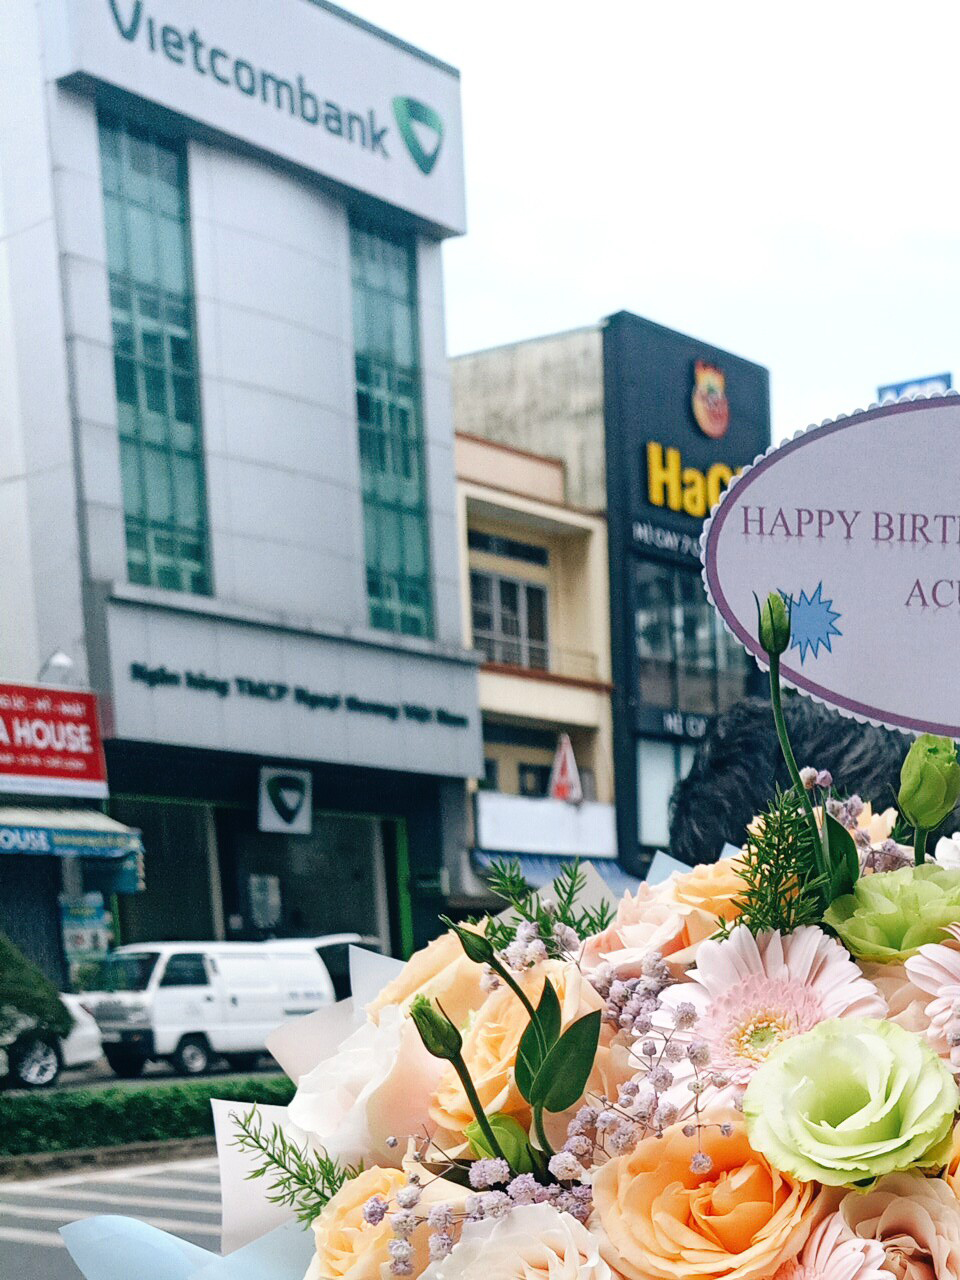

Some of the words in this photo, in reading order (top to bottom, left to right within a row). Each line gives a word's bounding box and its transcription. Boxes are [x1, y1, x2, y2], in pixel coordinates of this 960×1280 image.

[110, 0, 390, 159] Vietcombank
[646, 439, 742, 519] HaC
[741, 506, 861, 540] HAPPY
[12, 716, 94, 754] HOUSE
